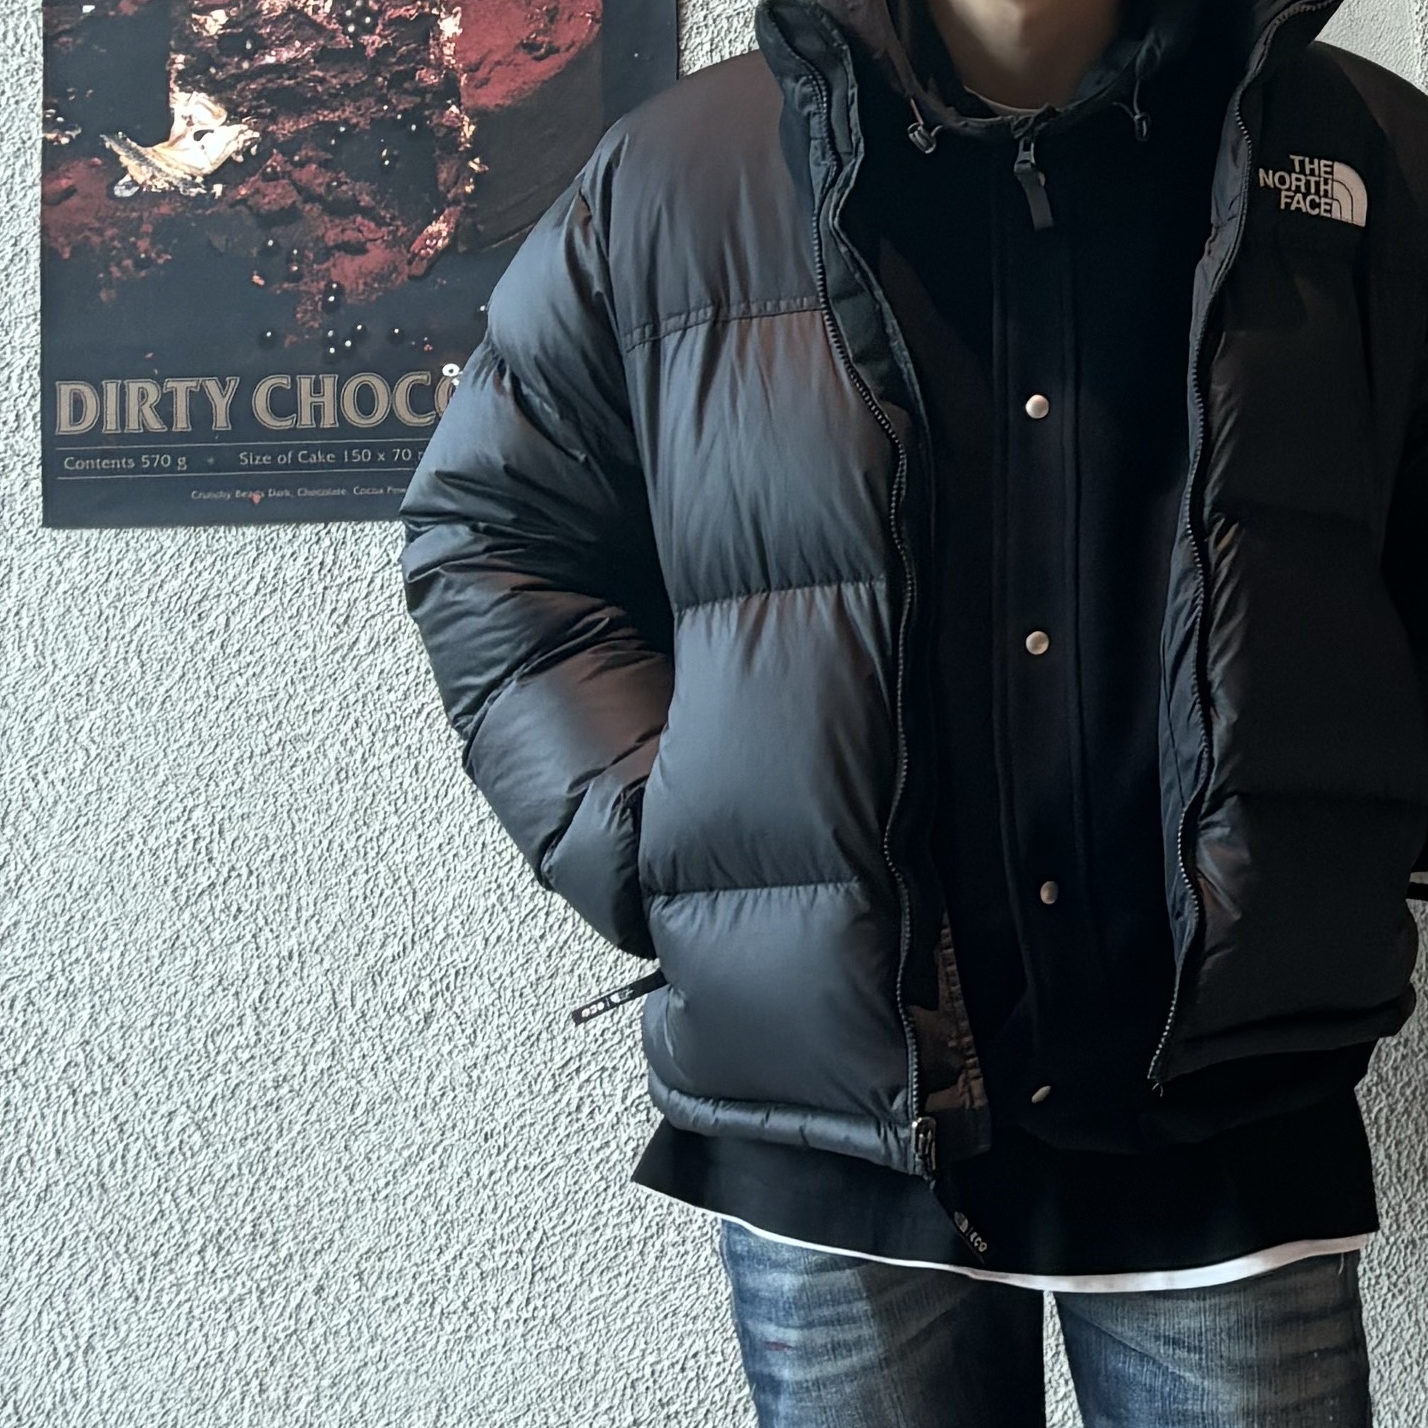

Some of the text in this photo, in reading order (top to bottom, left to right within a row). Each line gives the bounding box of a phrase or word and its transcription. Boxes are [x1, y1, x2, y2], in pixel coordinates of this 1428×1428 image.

[1289, 154, 1333, 179] THE
[1258, 167, 1333, 199] NORTH
[1280, 190, 1333, 218] FACE
[55, 376, 240, 435] DIRTY
[63, 453, 187, 471] Contents 570 g
[239, 451, 272, 465] Size
[277, 450, 293, 464] of
[297, 450, 336, 464] Cake
[343, 448, 372, 462] 150
[377, 452, 386, 461] x
[392, 448, 412, 461] 70
